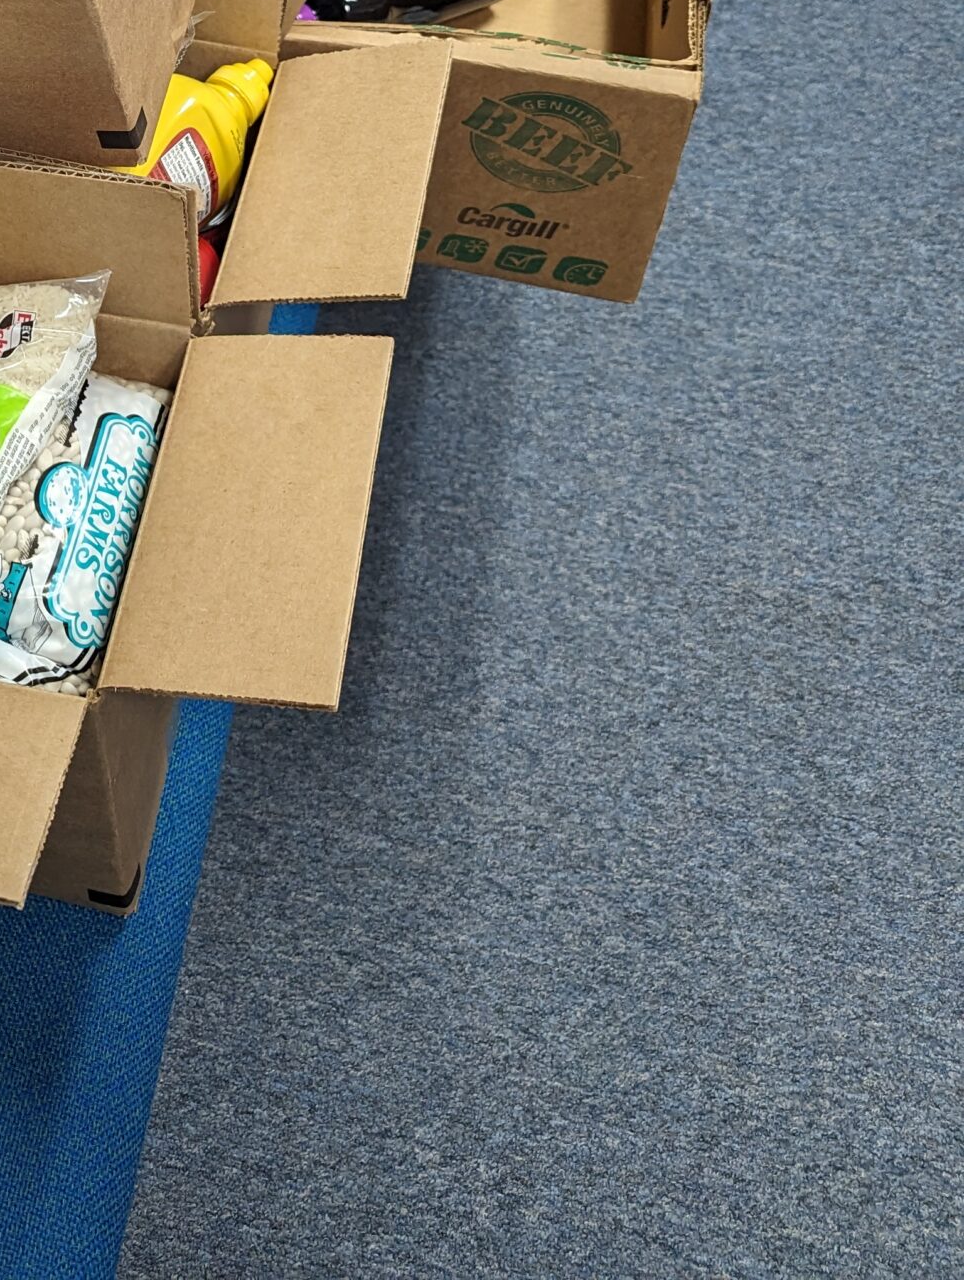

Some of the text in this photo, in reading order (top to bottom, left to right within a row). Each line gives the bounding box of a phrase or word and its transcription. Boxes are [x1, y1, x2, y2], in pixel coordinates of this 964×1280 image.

[462, 97, 632, 186] BEEF
[521, 99, 611, 148] GENUINELY
[183, 135, 205, 171] Nutrition Facts
[488, 150, 557, 187] BETTER
[457, 205, 560, 239] Cargill
[74, 455, 128, 574] FARMS
[88, 452, 156, 641] MORRISON
